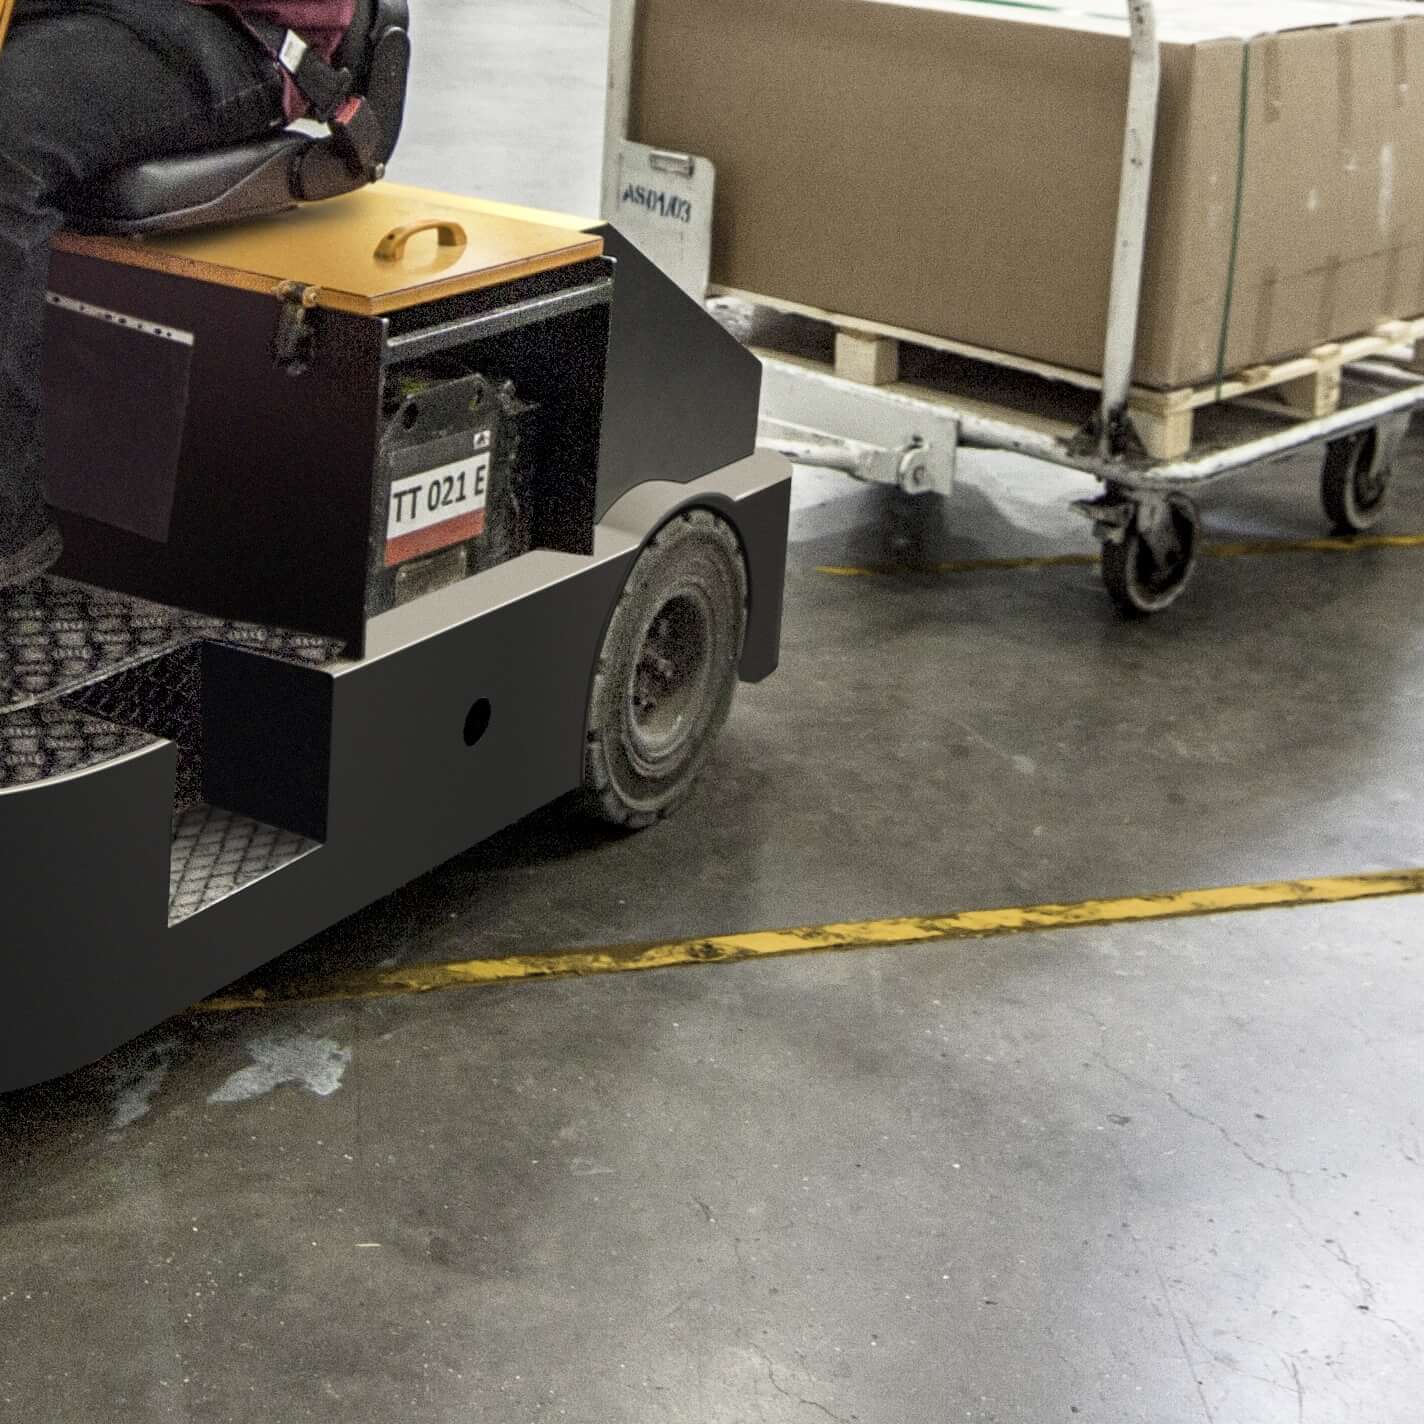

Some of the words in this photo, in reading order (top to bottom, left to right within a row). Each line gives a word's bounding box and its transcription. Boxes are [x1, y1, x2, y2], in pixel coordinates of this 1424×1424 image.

[622, 183, 691, 223] AS01/03
[393, 485, 423, 522] TT
[427, 471, 467, 512] 021
[474, 464, 487, 497] E
